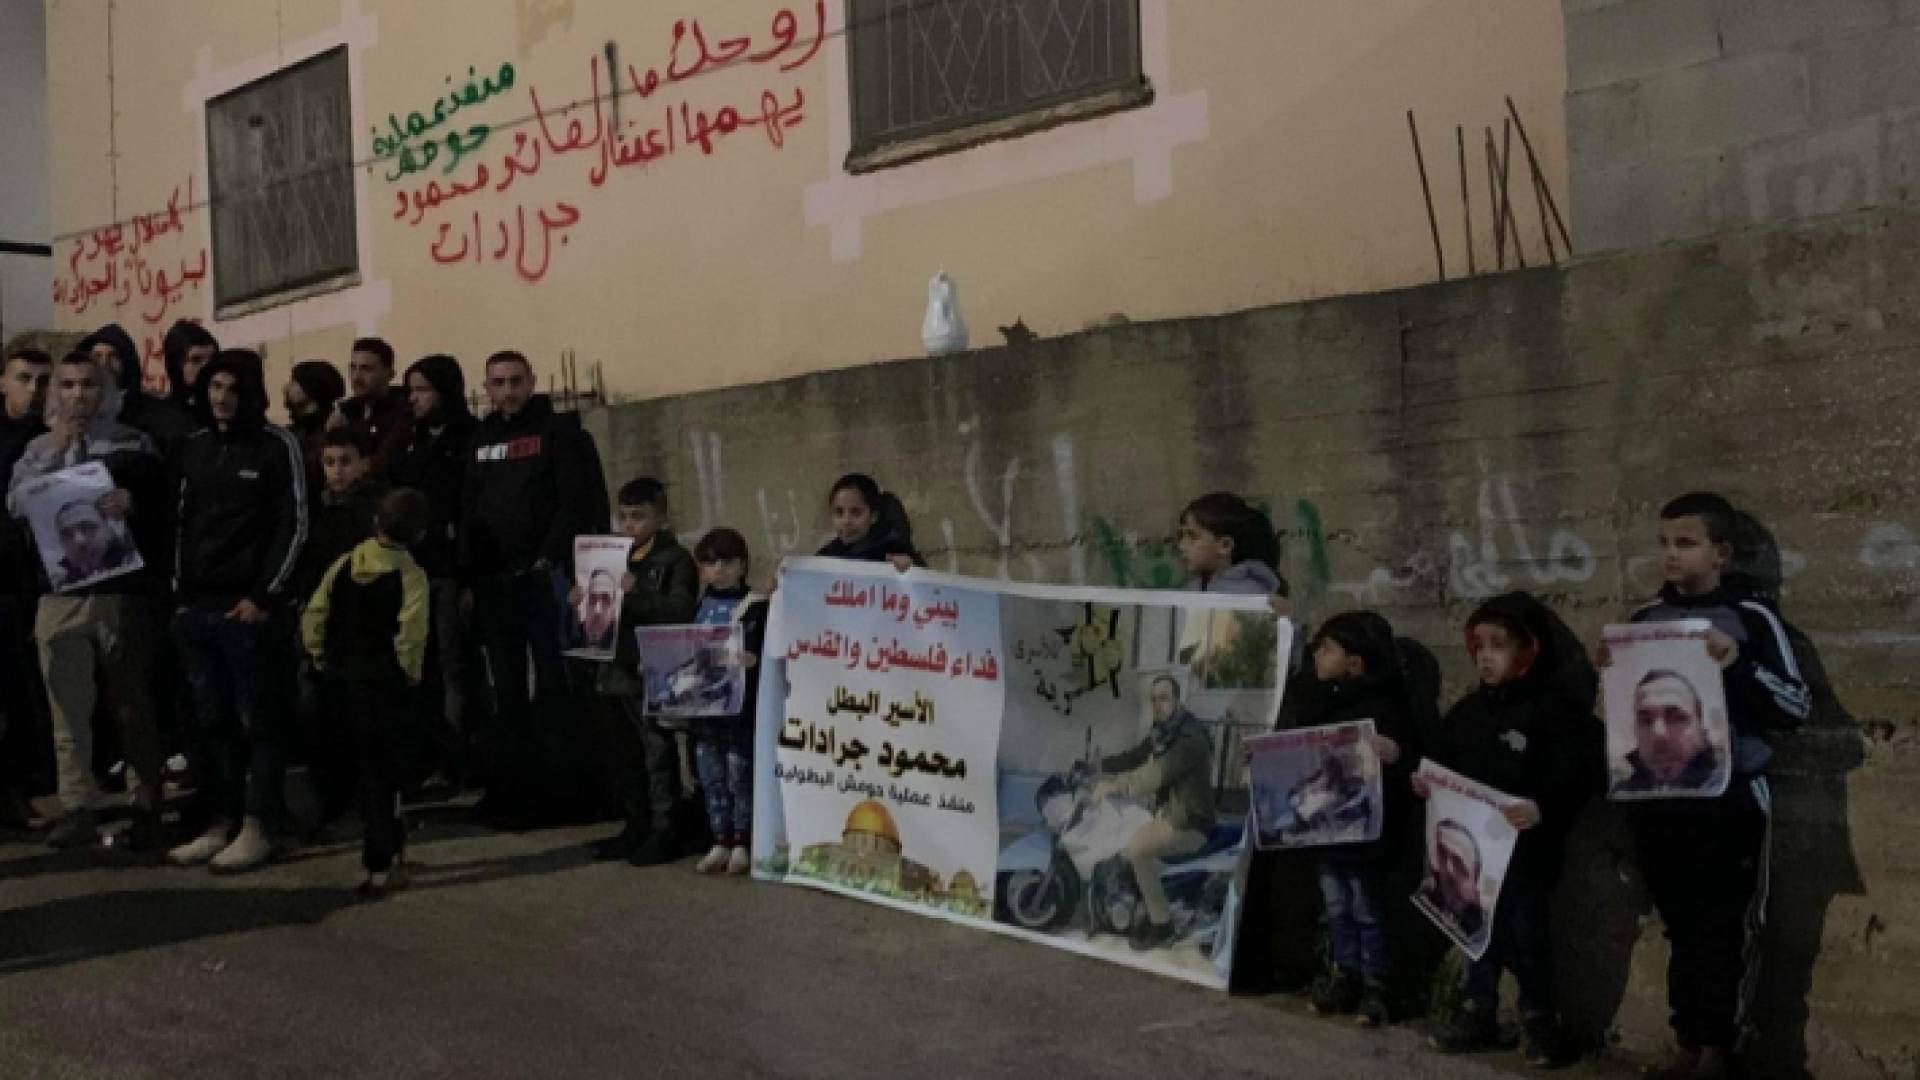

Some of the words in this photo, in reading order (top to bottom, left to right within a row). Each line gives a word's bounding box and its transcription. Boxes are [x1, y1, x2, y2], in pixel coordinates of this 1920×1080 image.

[786, 628, 862, 670] والقدس
[866, 636, 949, 673] فلسطين
[952, 648, 999, 681] فداء
[826, 684, 881, 722] البطل
[881, 689, 935, 727] الأسير
[778, 717, 871, 771] جرادات
[877, 740, 969, 780] محمود
